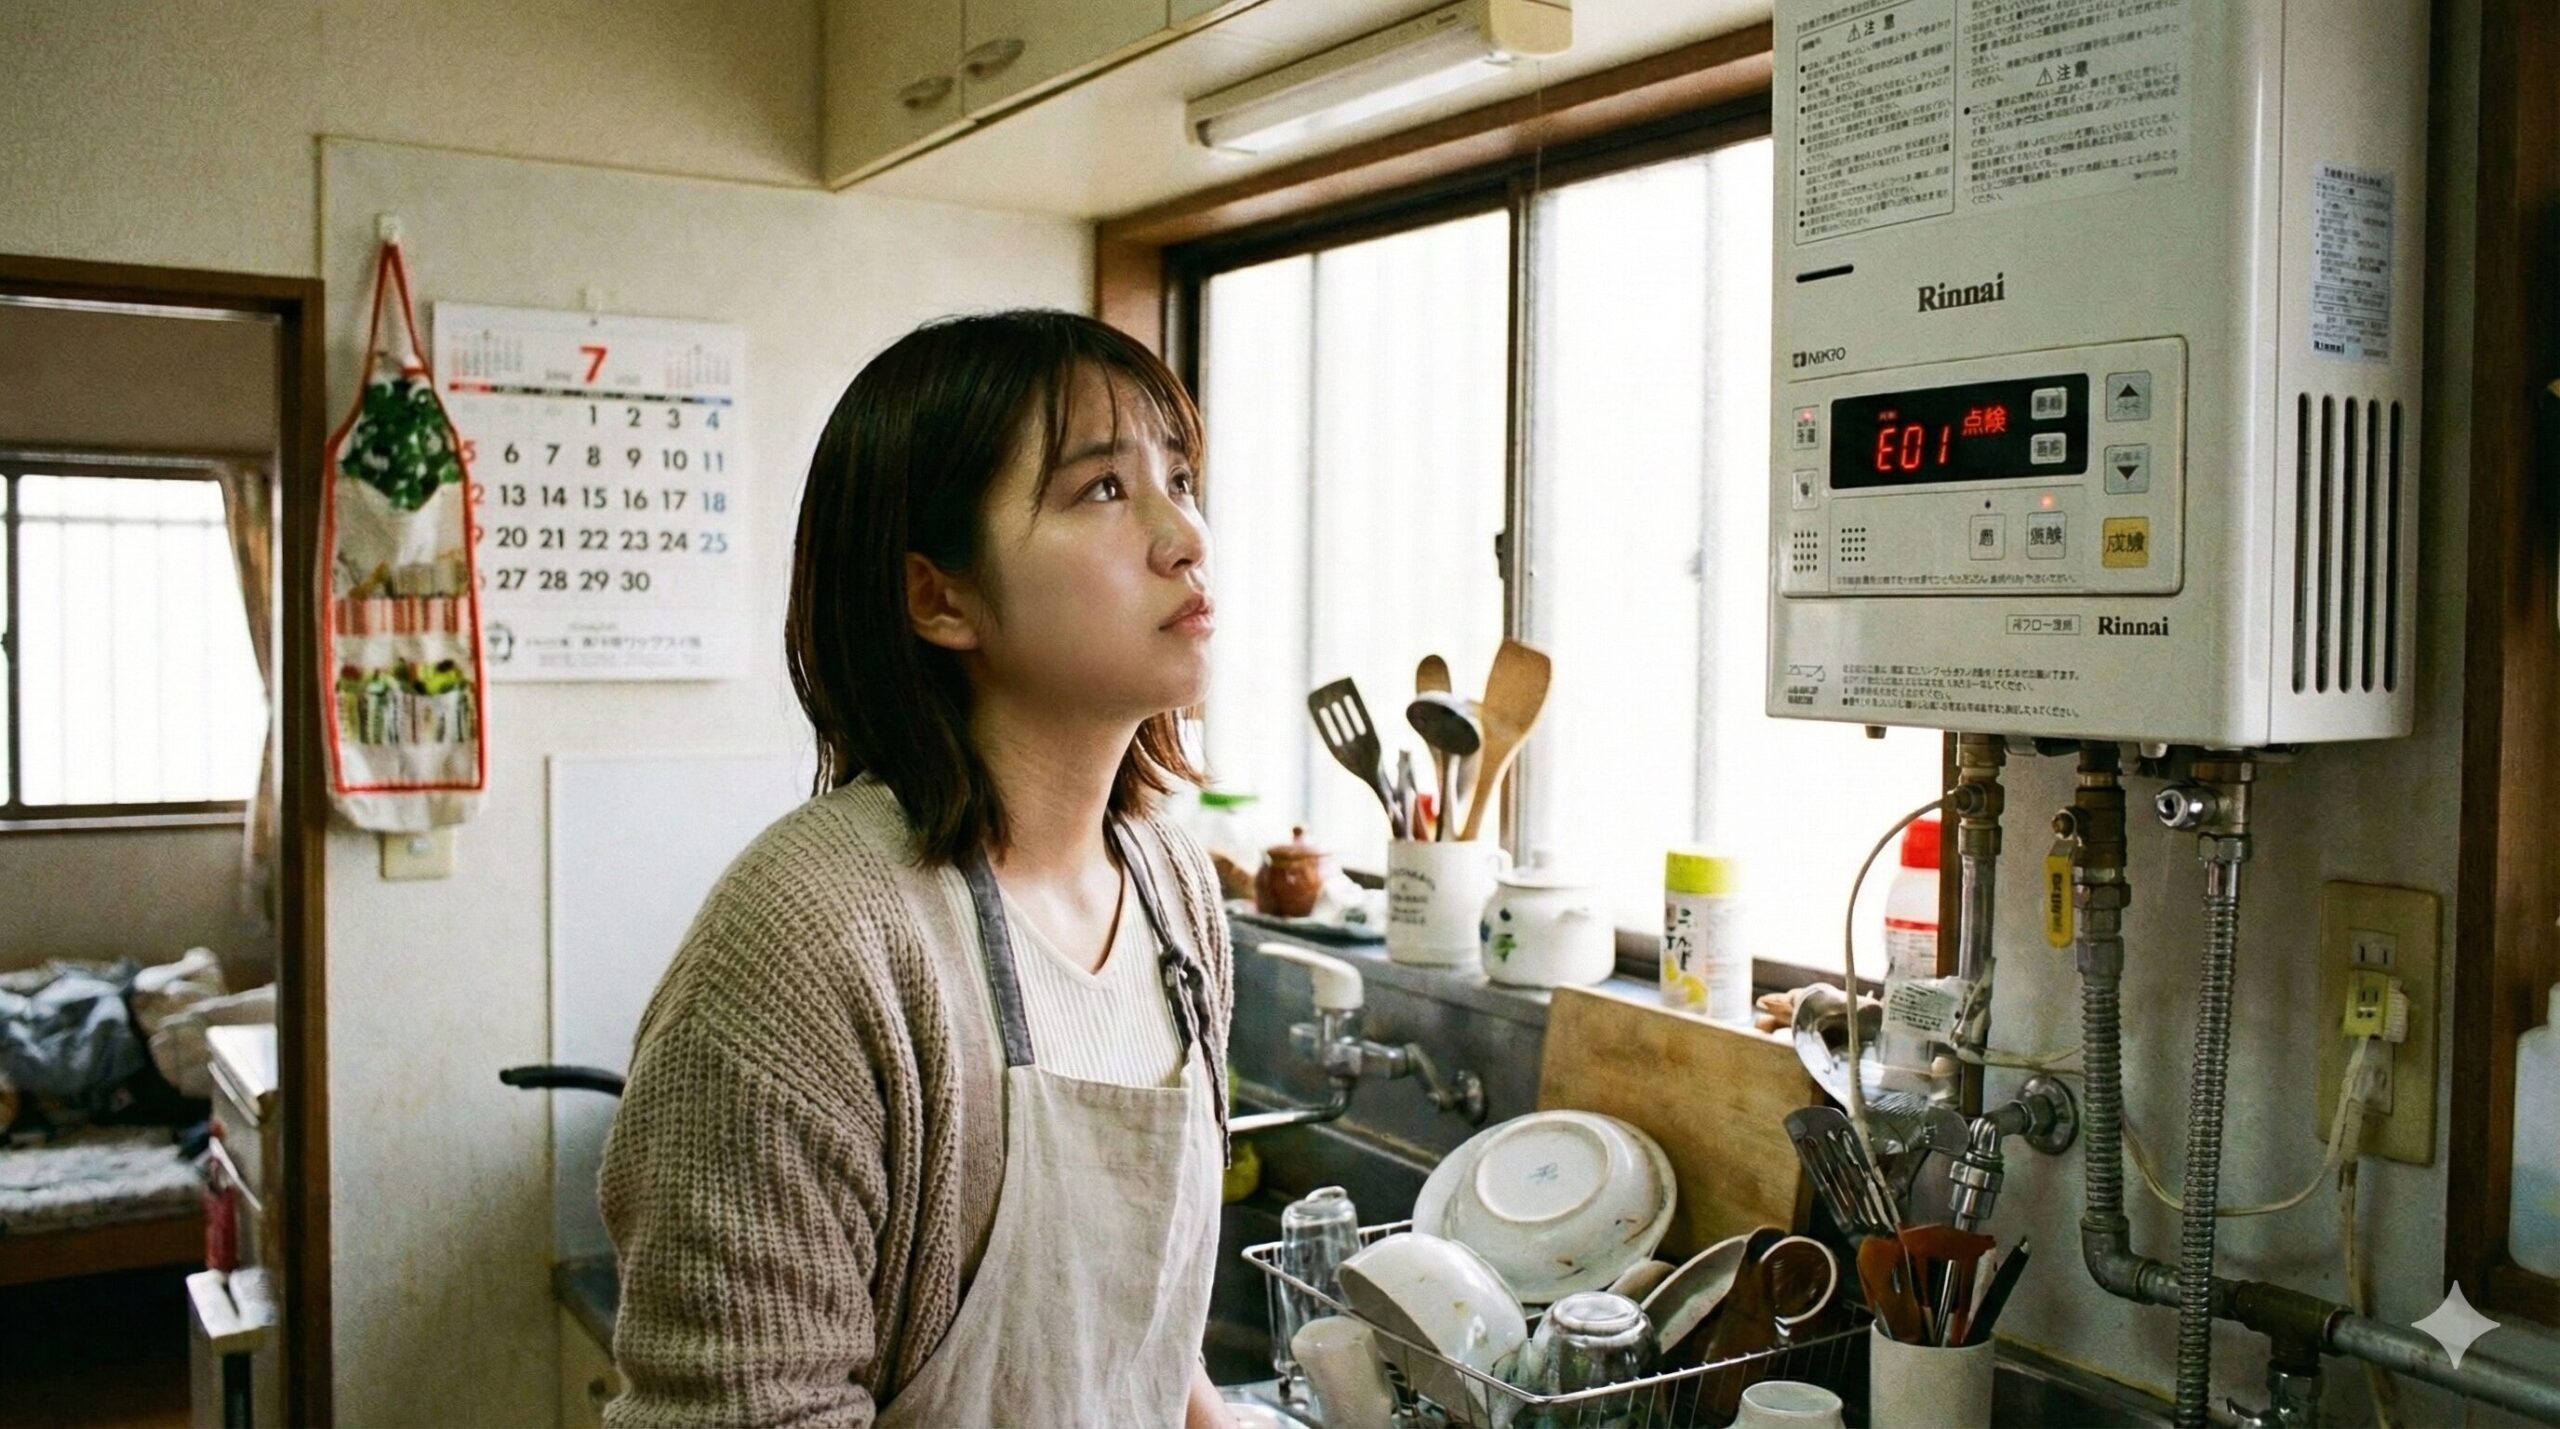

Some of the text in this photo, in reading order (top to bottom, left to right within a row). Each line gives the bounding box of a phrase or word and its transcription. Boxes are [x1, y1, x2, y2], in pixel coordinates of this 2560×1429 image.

[1917, 272, 2005, 313] Rinnai
[580, 345, 607, 384] 7
[588, 404, 720, 430] 1 2 3 4
[463, 441, 724, 472] 5 6 7 8 9 10 11
[1876, 425, 1949, 470] E01
[500, 484, 527, 507] 13
[541, 485, 567, 507] 14
[582, 487, 607, 509] 15
[623, 488, 648, 511] 16
[662, 489, 688, 510] 17
[703, 491, 726, 513] 18
[496, 526, 528, 548] 20
[539, 528, 564, 549] 21
[579, 529, 609, 550] 22
[620, 530, 649, 551] 23
[659, 531, 688, 552] 24
[699, 532, 728, 554] 25
[497, 568, 527, 590] 27
[539, 569, 568, 591] 28
[579, 570, 610, 591] 29
[621, 570, 651, 592] 30
[2097, 615, 2169, 637] Rinnai
